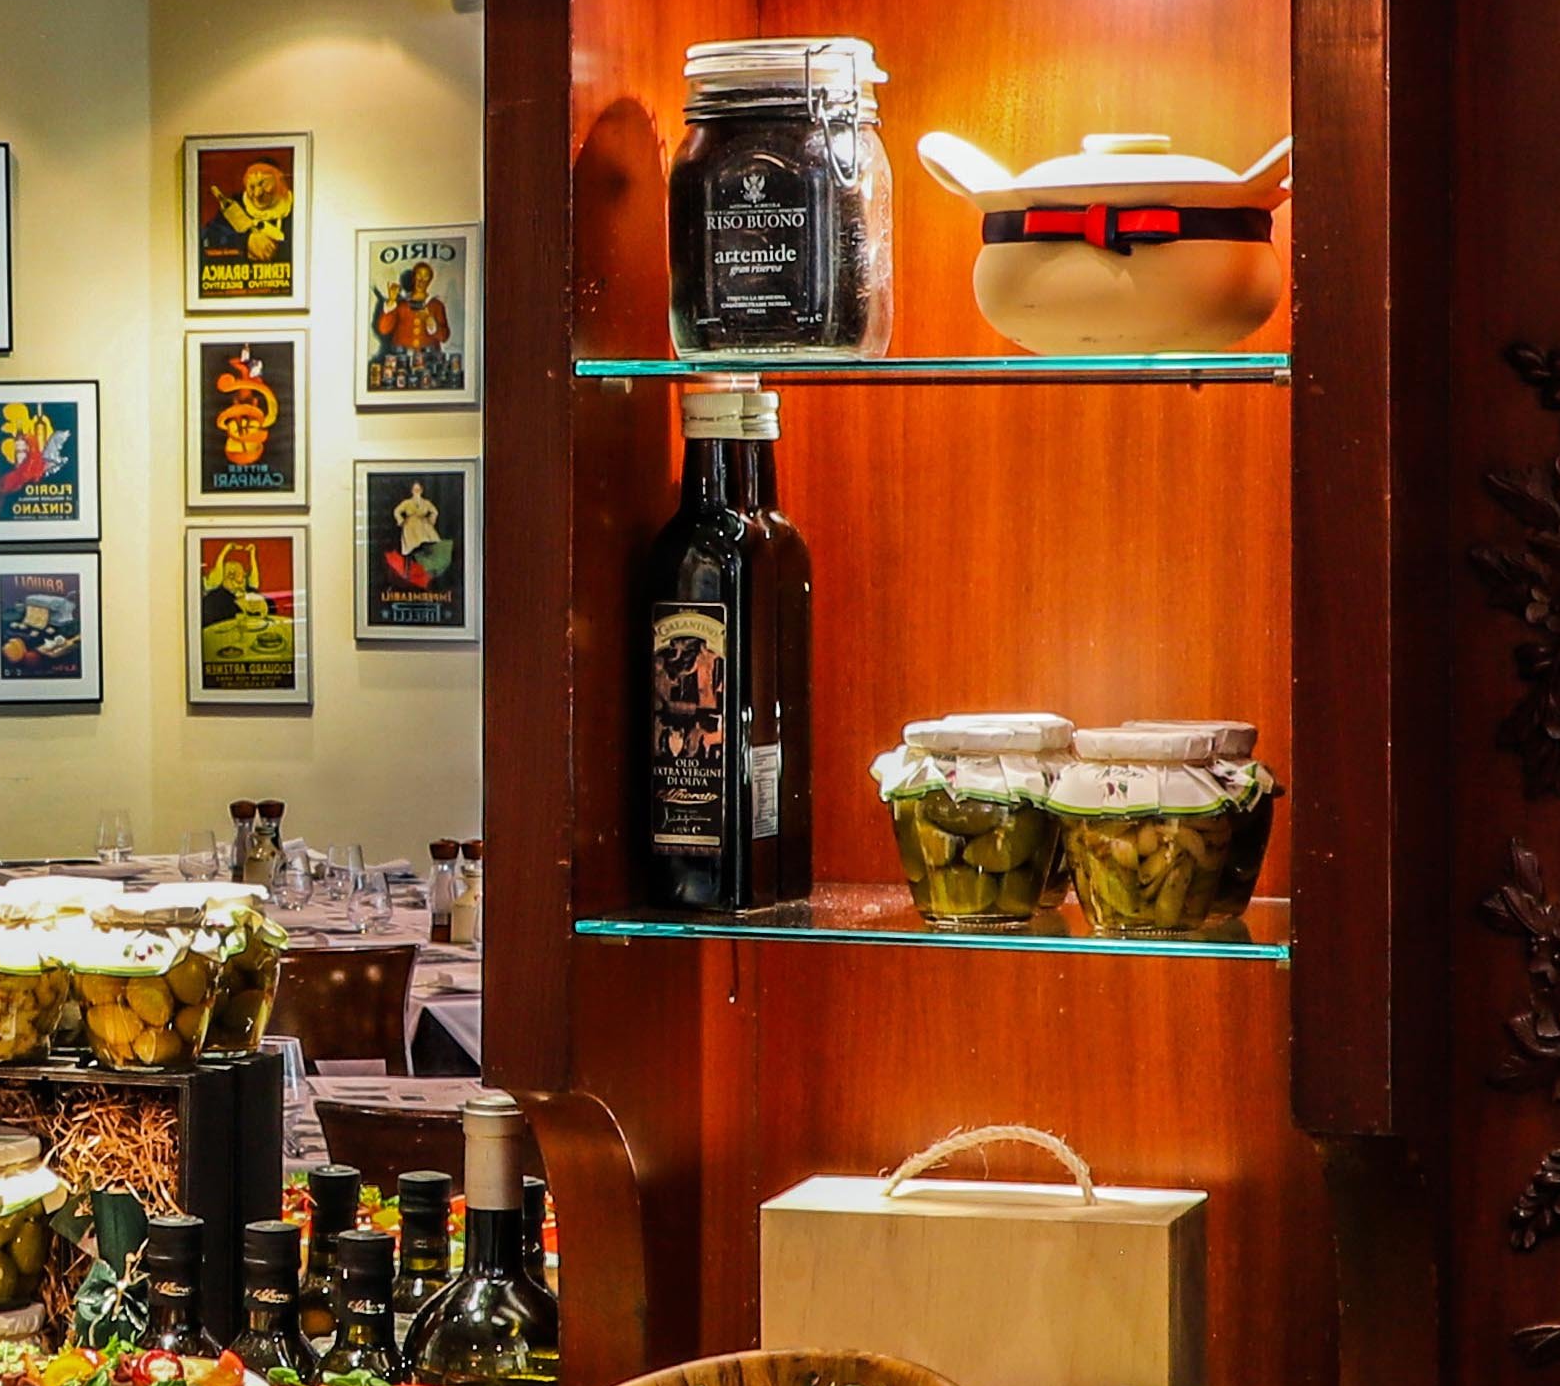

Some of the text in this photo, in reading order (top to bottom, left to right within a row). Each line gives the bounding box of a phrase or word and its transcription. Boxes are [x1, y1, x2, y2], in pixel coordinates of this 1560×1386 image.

[707, 212, 806, 231] RISO BUONO
[714, 243, 798, 265] artemide
[675, 758, 700, 768] OLIO
[682, 767, 722, 779] VERGINE
[667, 776, 709, 787] DI OLIVA
